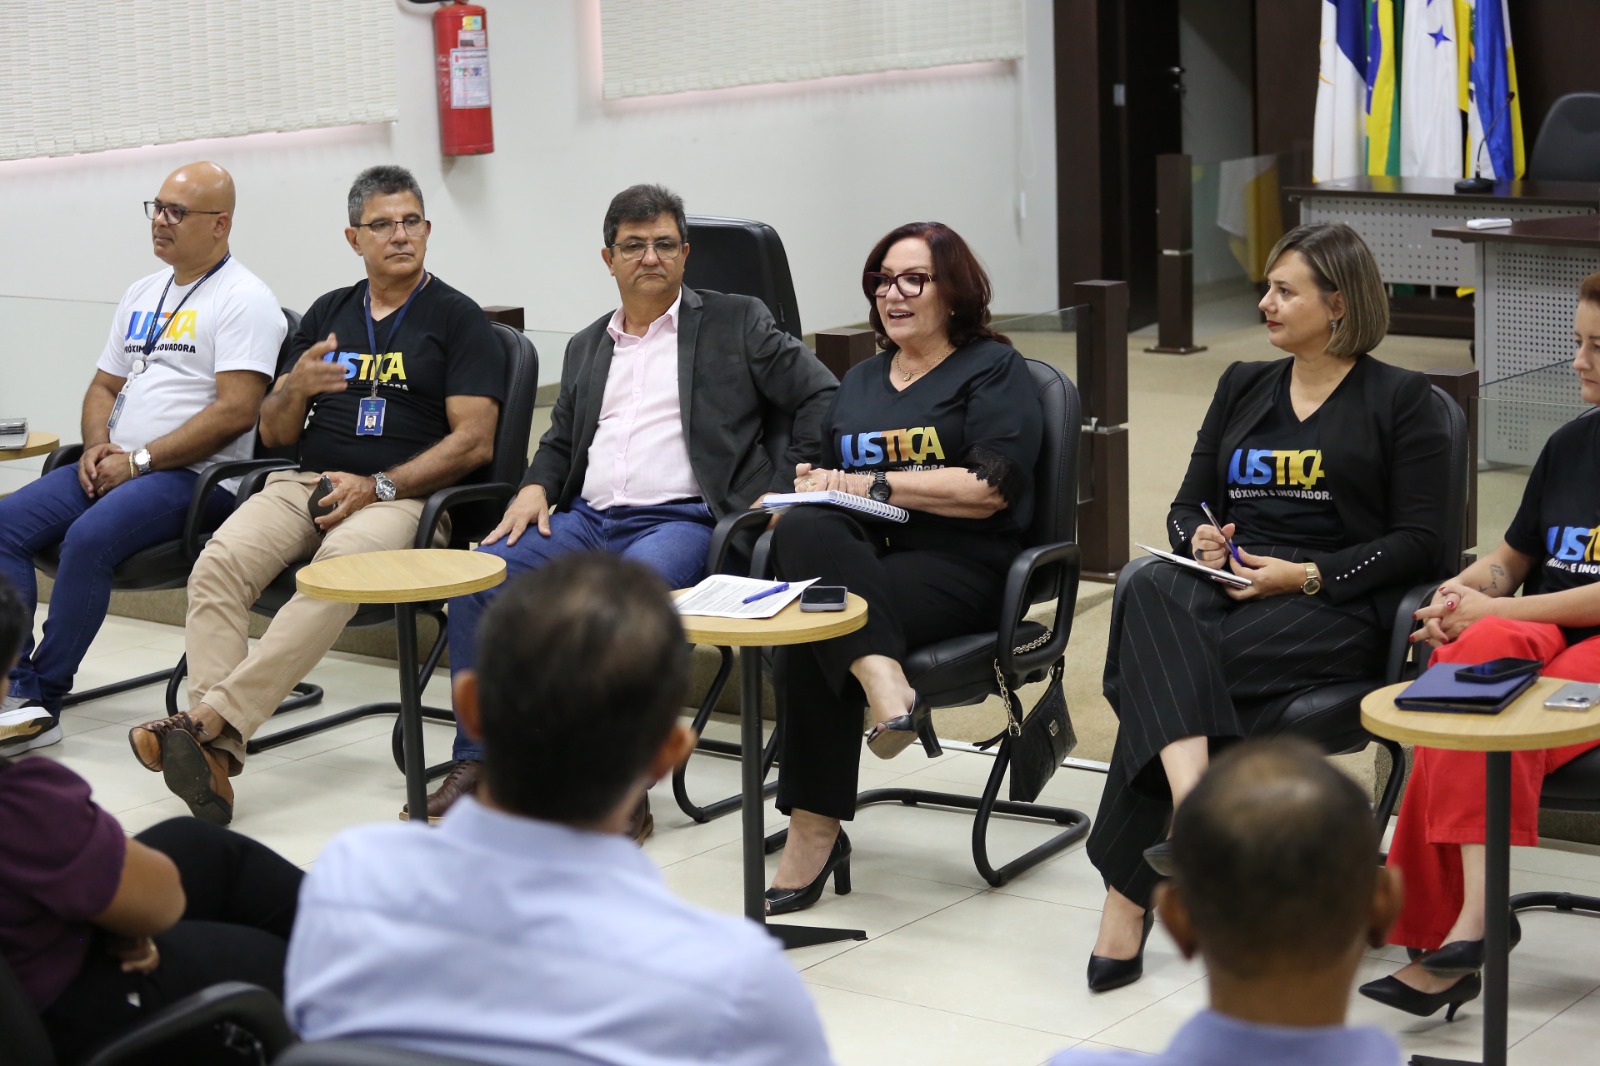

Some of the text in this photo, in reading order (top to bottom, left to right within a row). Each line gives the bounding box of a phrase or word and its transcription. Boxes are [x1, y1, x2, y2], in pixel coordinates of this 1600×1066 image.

[841, 426, 945, 469] JUSTIÇA
[1276, 489, 1333, 500] INOVADOR
[1570, 563, 1577, 573] E
[1578, 563, 1600, 575] INO
